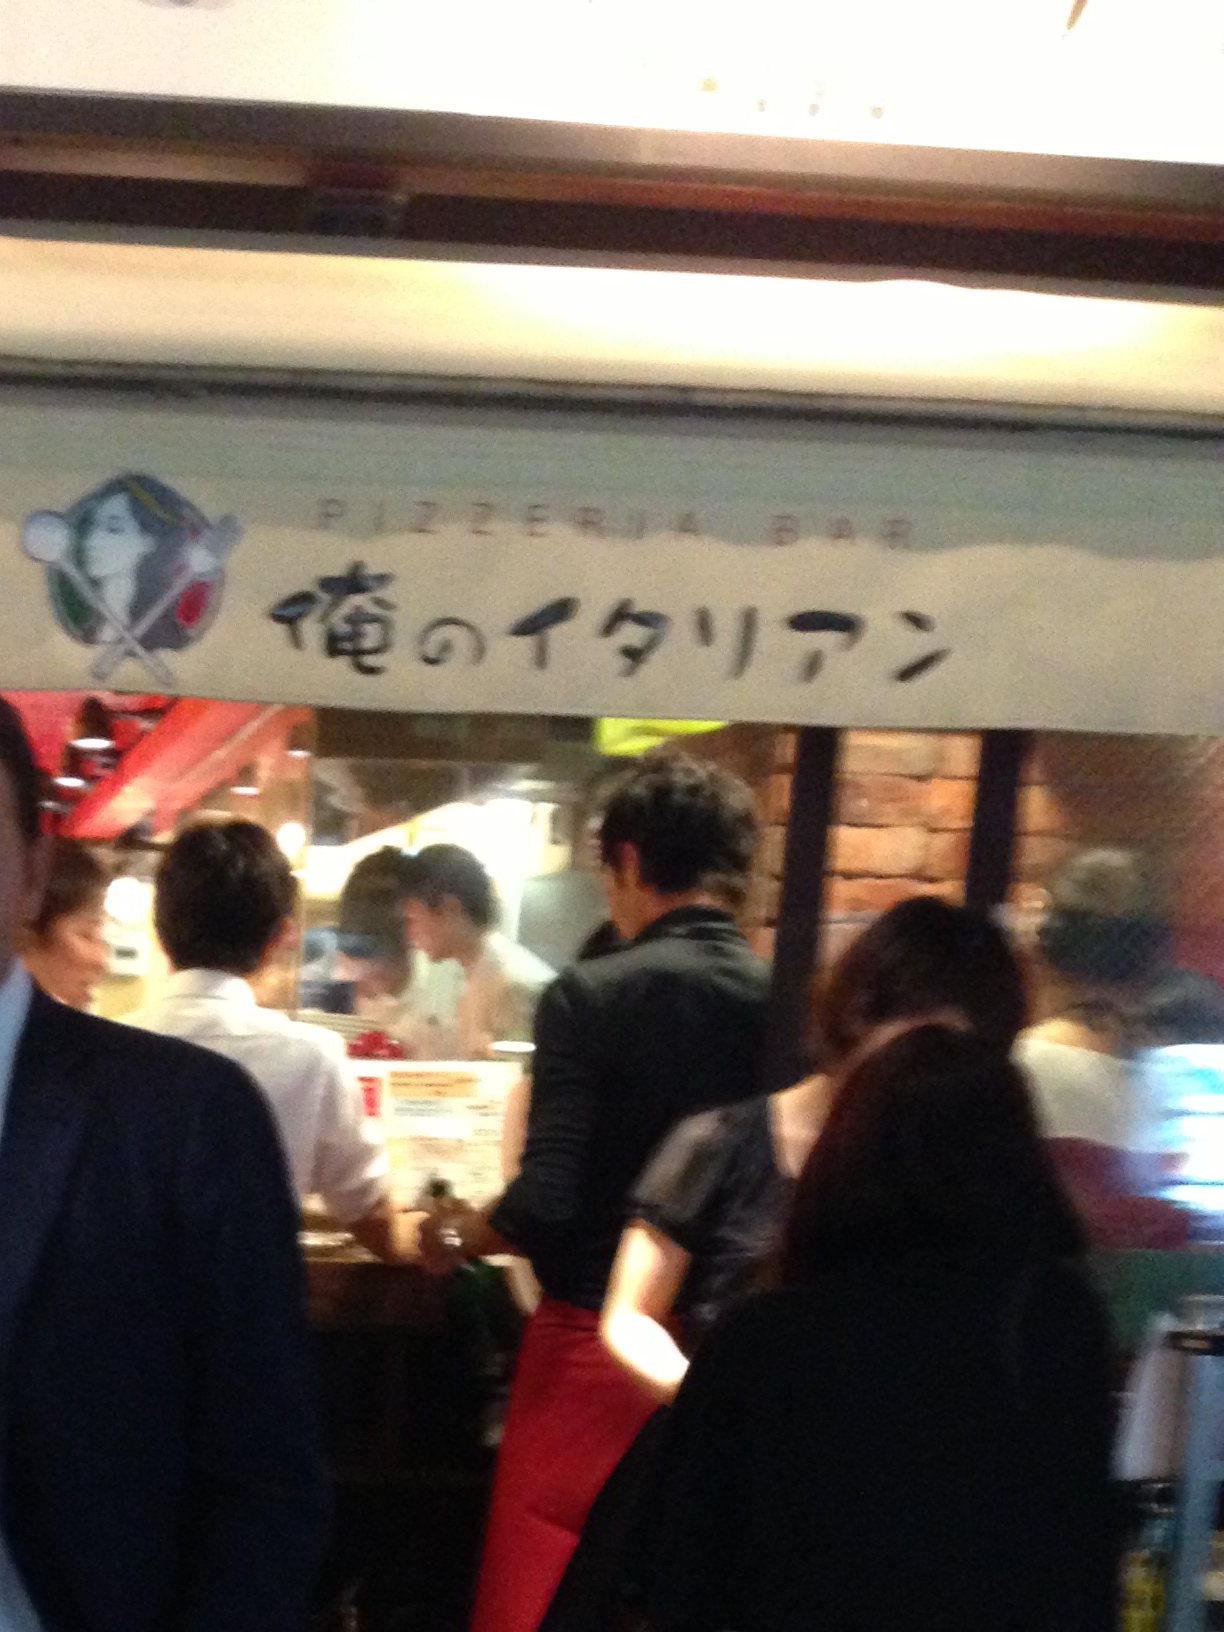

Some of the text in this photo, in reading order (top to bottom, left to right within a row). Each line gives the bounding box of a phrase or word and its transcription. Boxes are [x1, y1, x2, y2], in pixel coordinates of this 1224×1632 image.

[318, 498, 913, 550] PIZZERIA BAR
[270, 561, 953, 684] 俺のイタリアン
